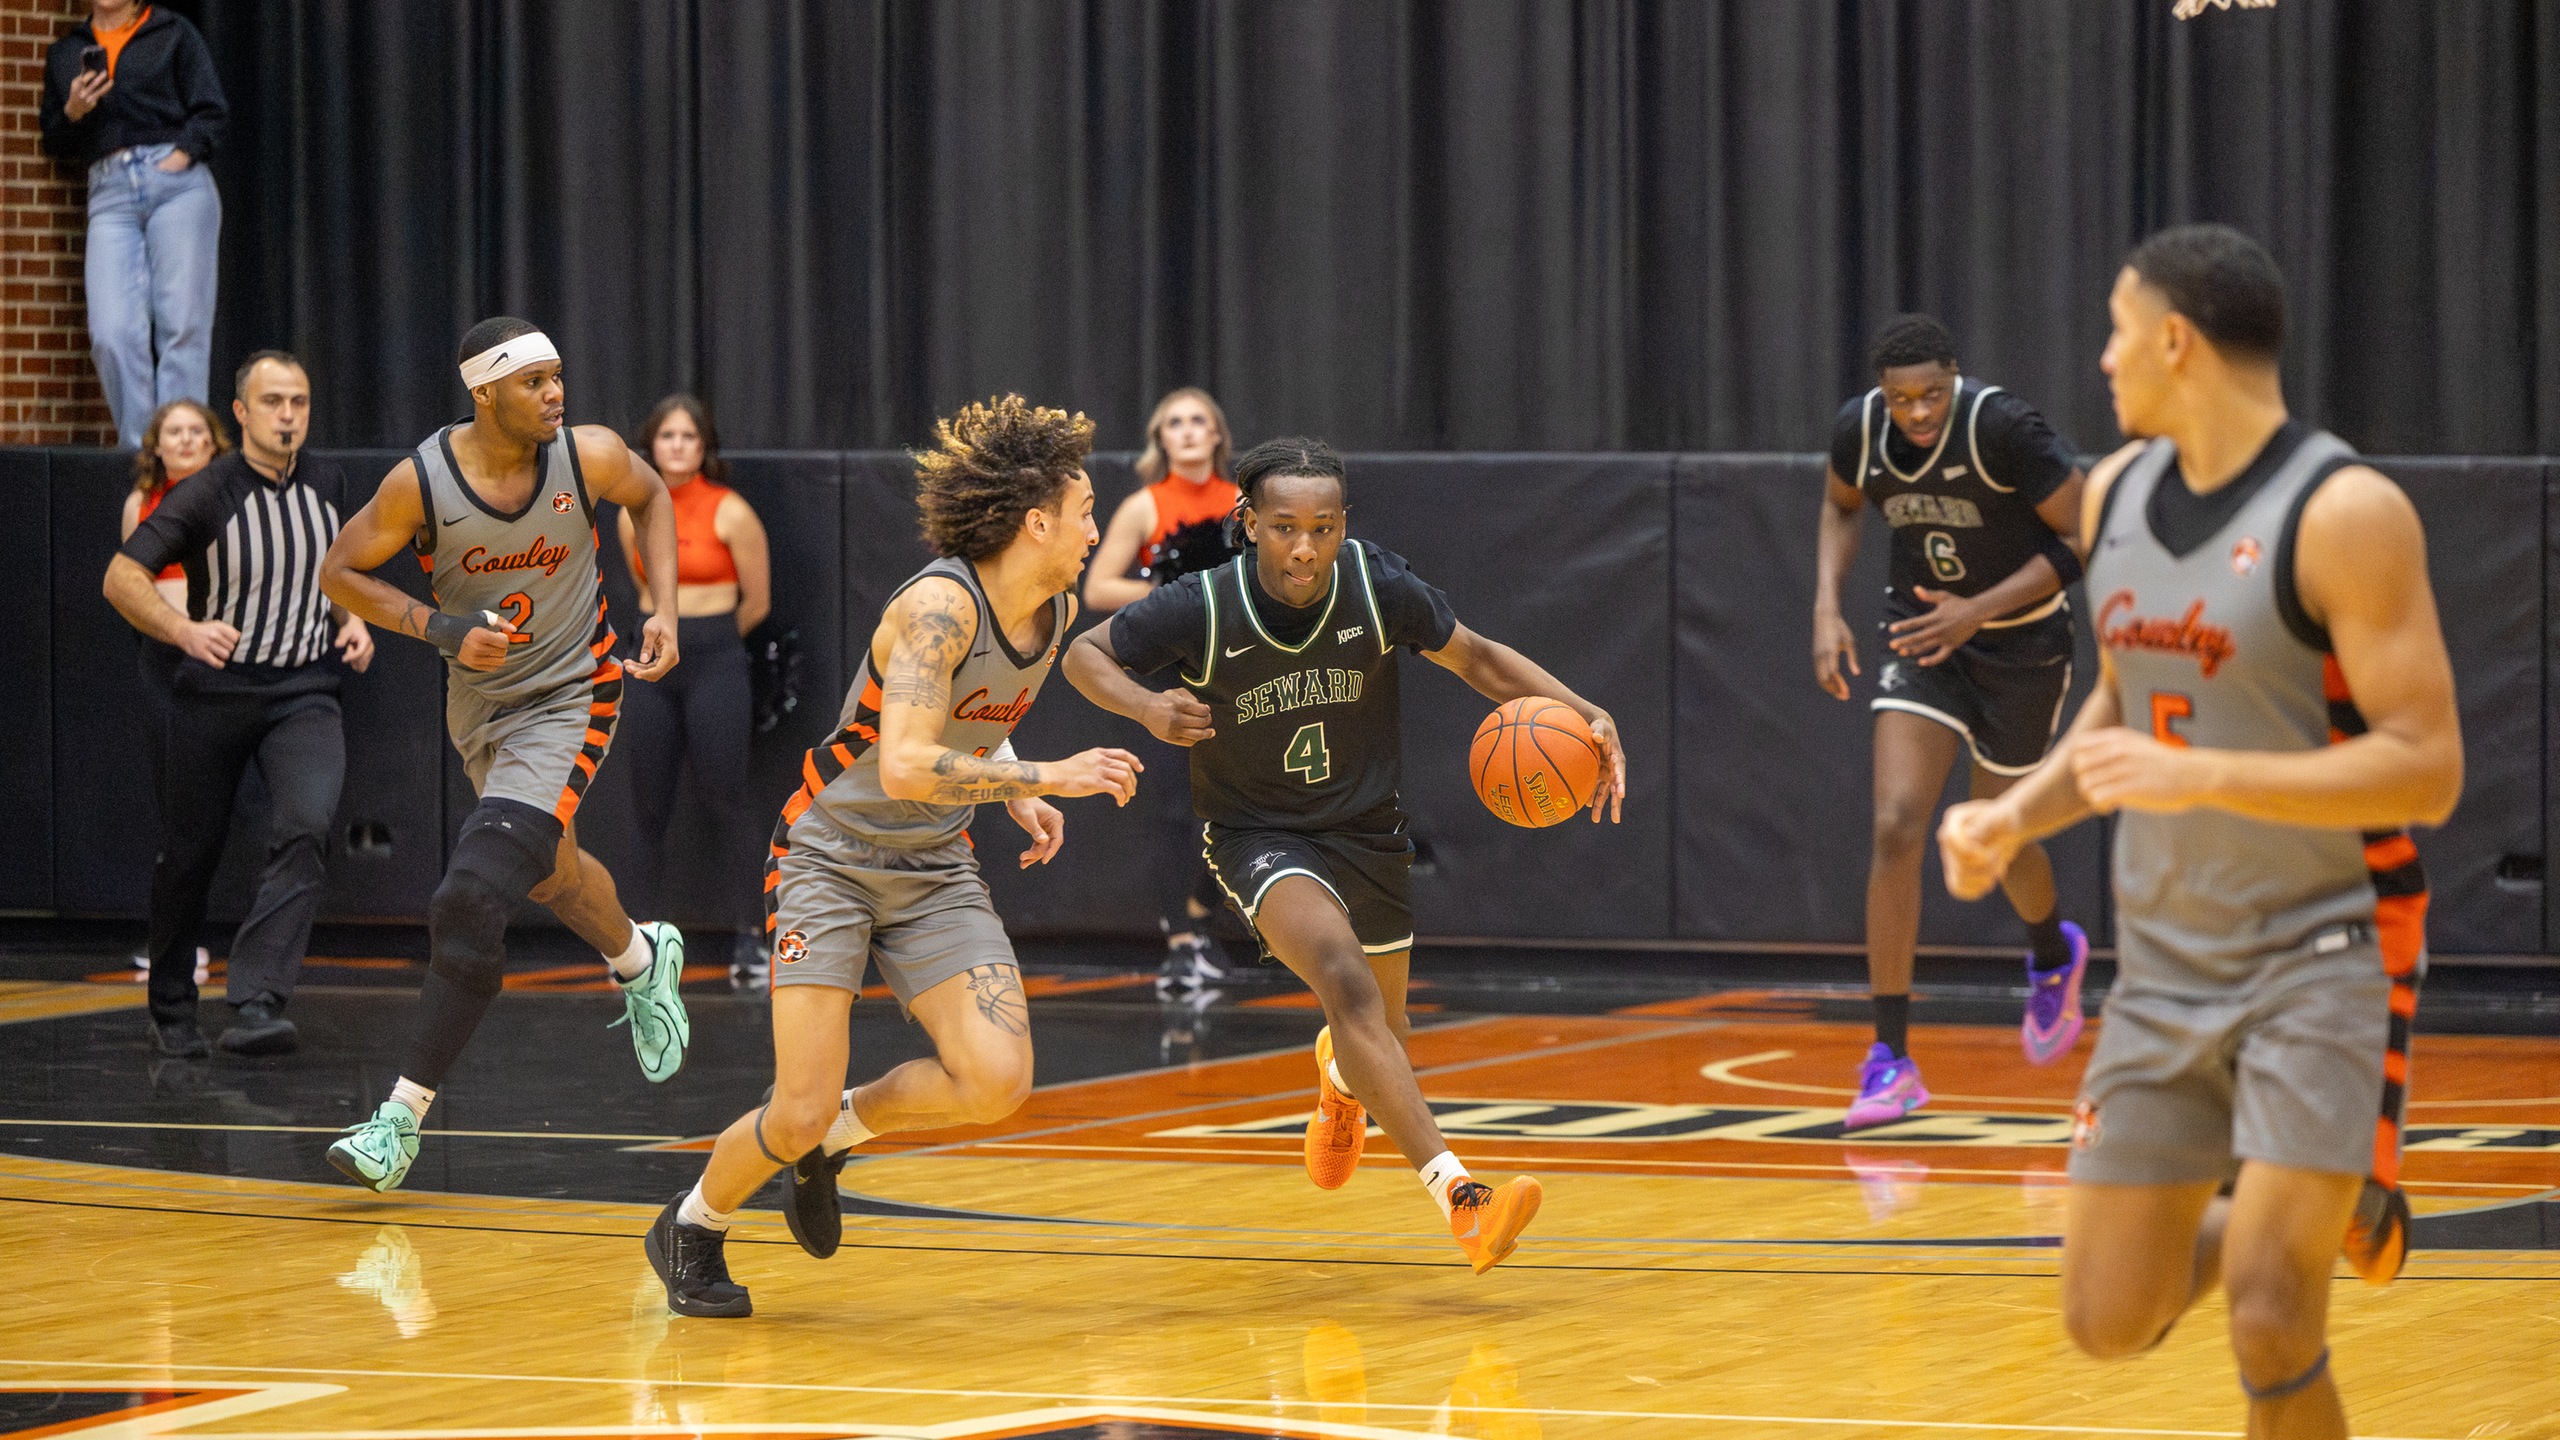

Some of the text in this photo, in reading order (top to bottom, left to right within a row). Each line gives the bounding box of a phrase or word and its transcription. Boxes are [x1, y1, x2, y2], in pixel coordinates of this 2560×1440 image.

[460, 534, 570, 579] Cowley
[1923, 530, 1967, 582] 6
[500, 591, 534, 644] 2
[1336, 625, 1364, 645] KJCCC
[2095, 586, 2237, 682] Cowley
[1235, 668, 1364, 725] SEWARD
[2150, 692, 2192, 749] 5
[1283, 721, 1331, 784] 4
